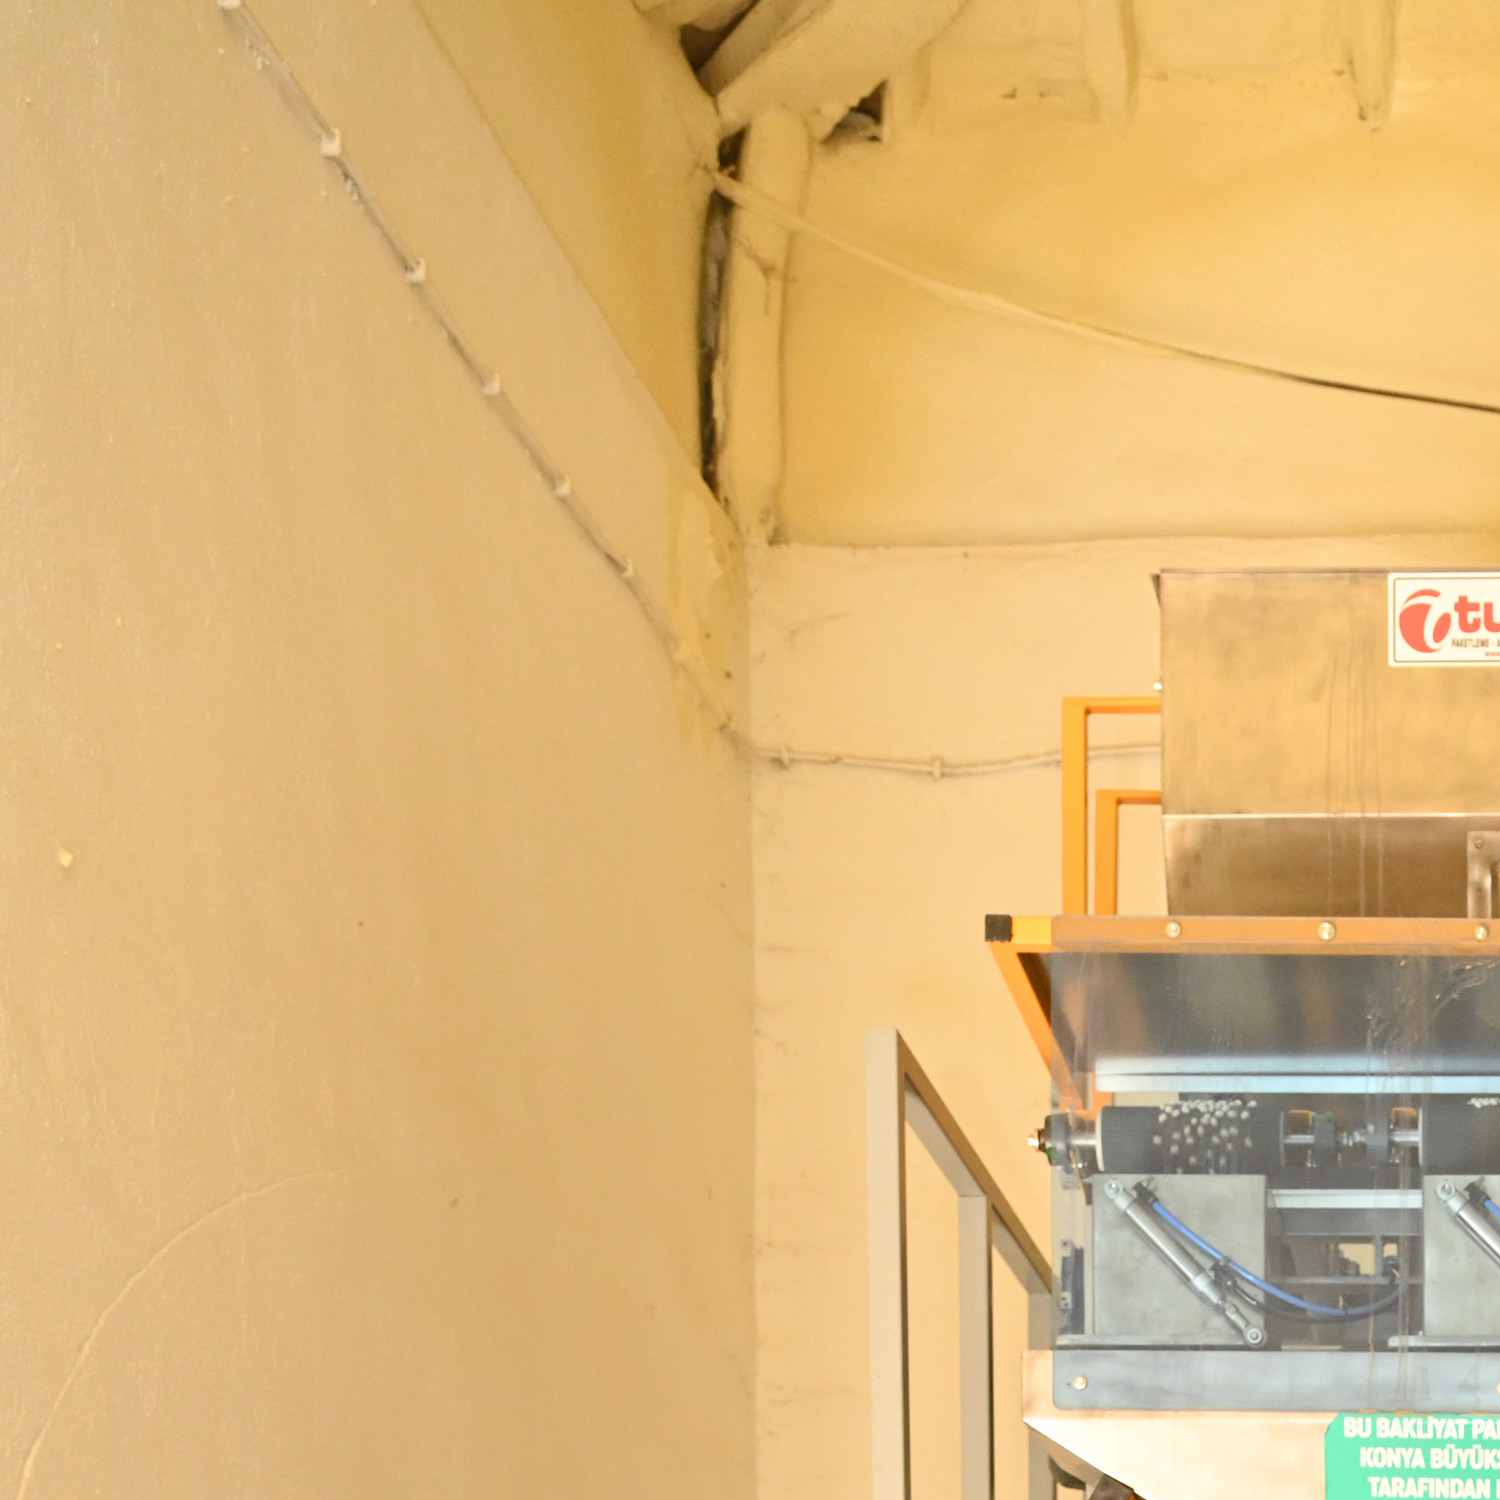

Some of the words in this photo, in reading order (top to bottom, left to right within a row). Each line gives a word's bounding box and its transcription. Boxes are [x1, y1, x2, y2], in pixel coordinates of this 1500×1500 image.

[1344, 1417, 1372, 1437] BU
[1376, 1417, 1468, 1439] BAKLİYAT
[1360, 1447, 1425, 1469] KONYA
[1368, 1476, 1491, 1500] TARAFINDAN
